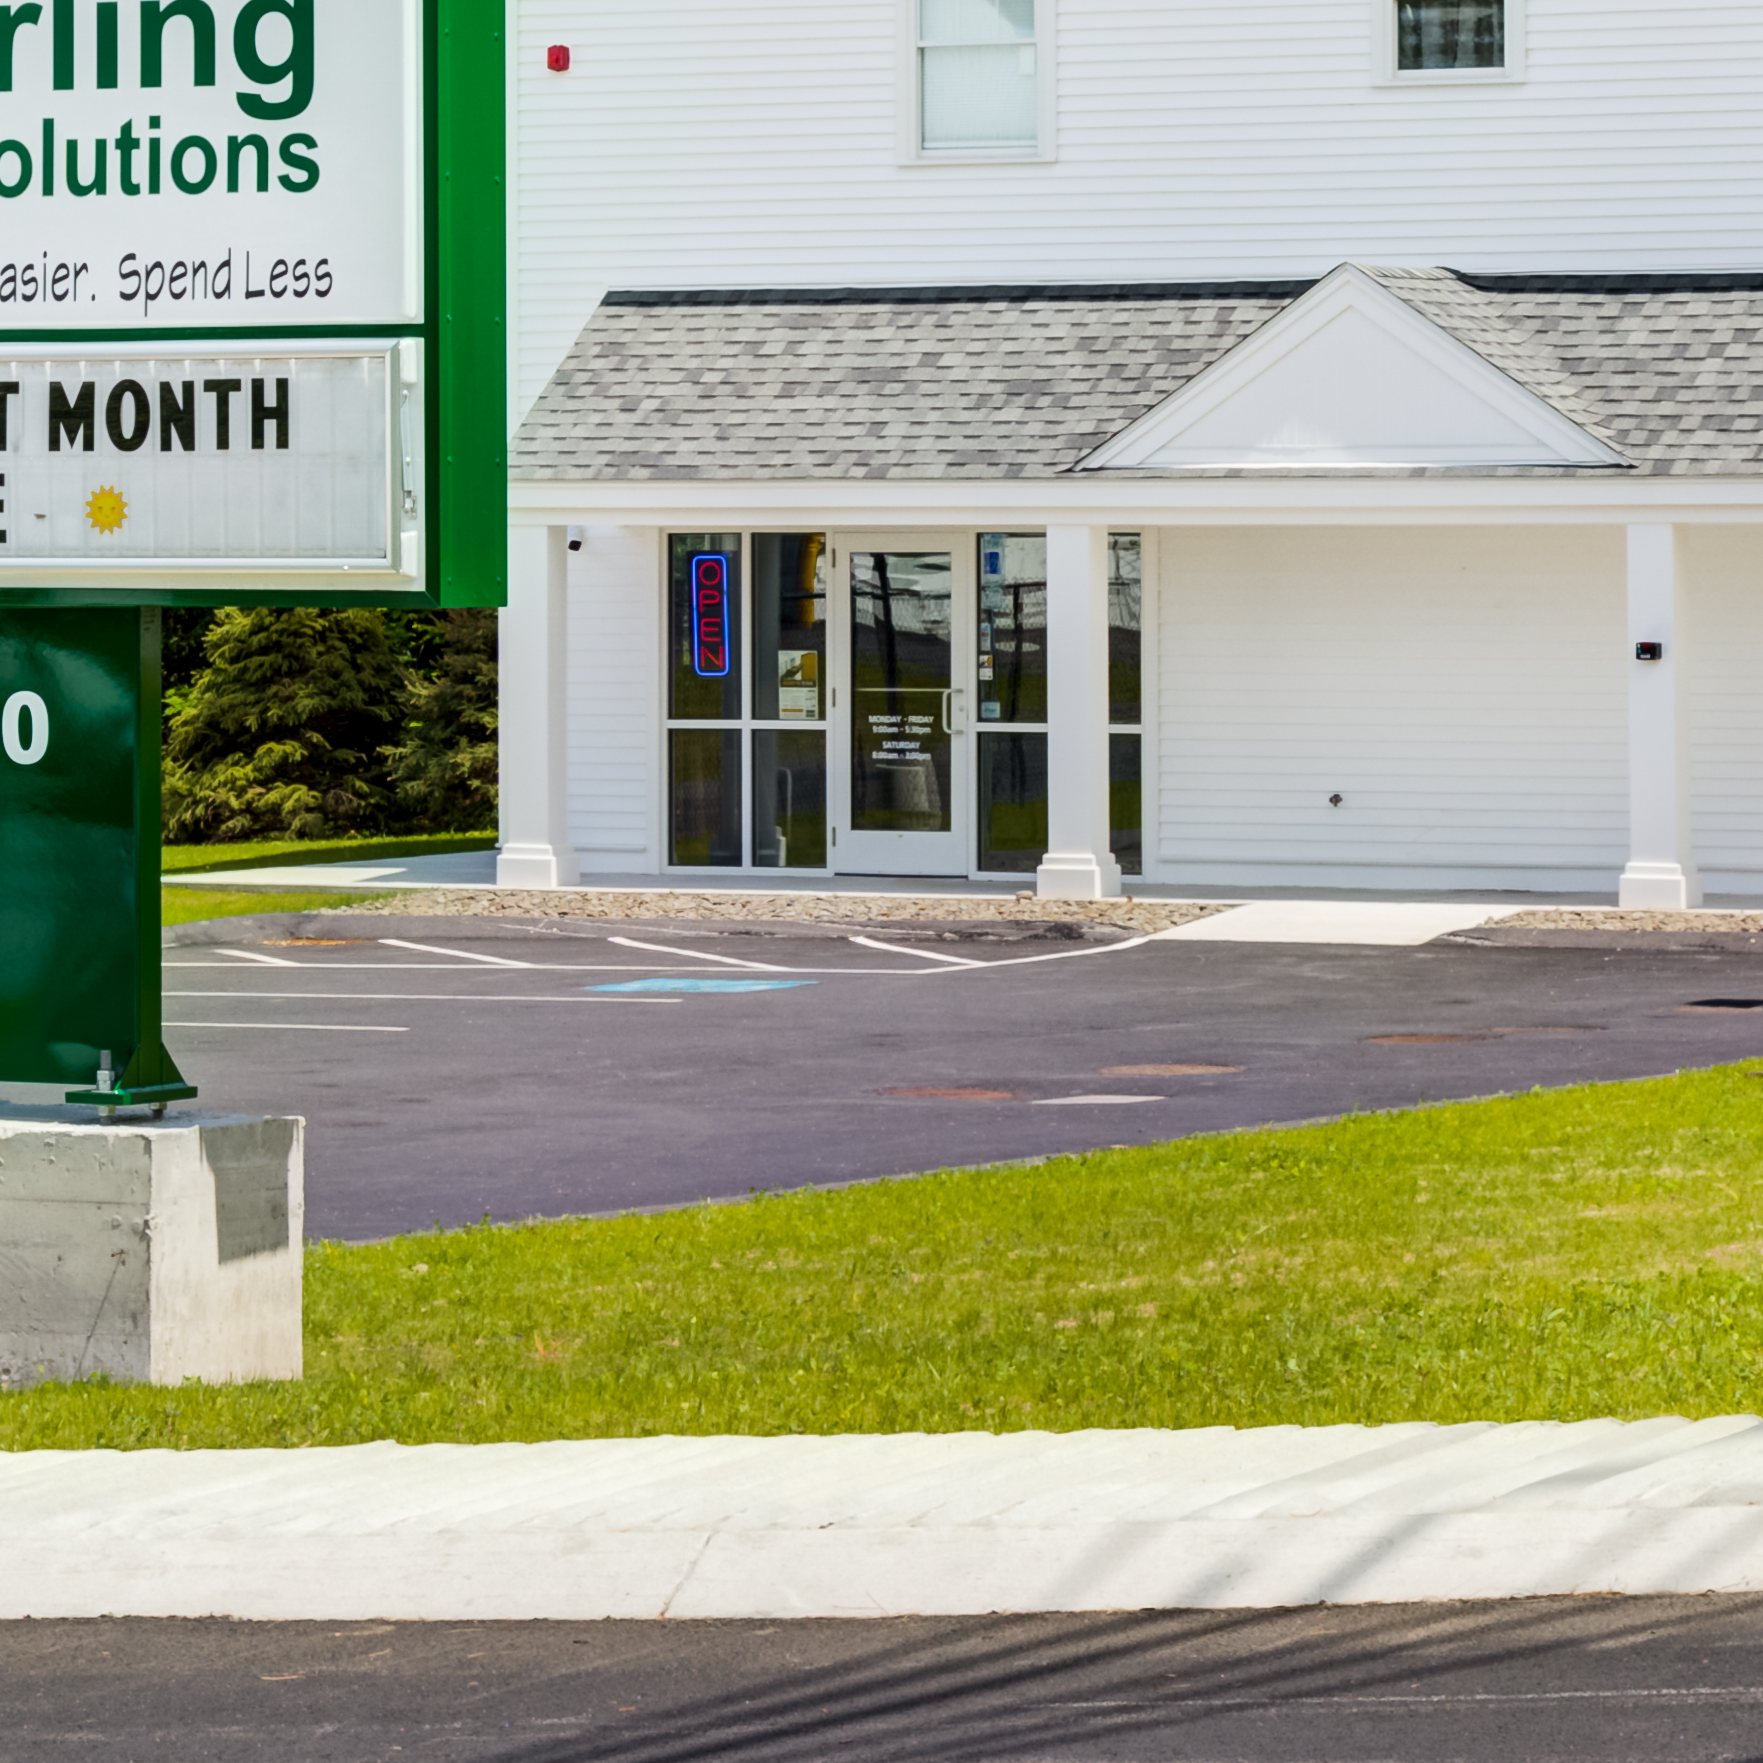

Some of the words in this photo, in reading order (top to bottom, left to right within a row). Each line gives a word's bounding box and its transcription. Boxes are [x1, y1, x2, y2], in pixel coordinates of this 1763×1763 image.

[120, 248, 230, 316] Spend
[245, 252, 332, 299] Less
[49, 378, 289, 451] MONTH
[699, 562, 723, 667] OPEN
[869, 715, 902, 724] MONDAY
